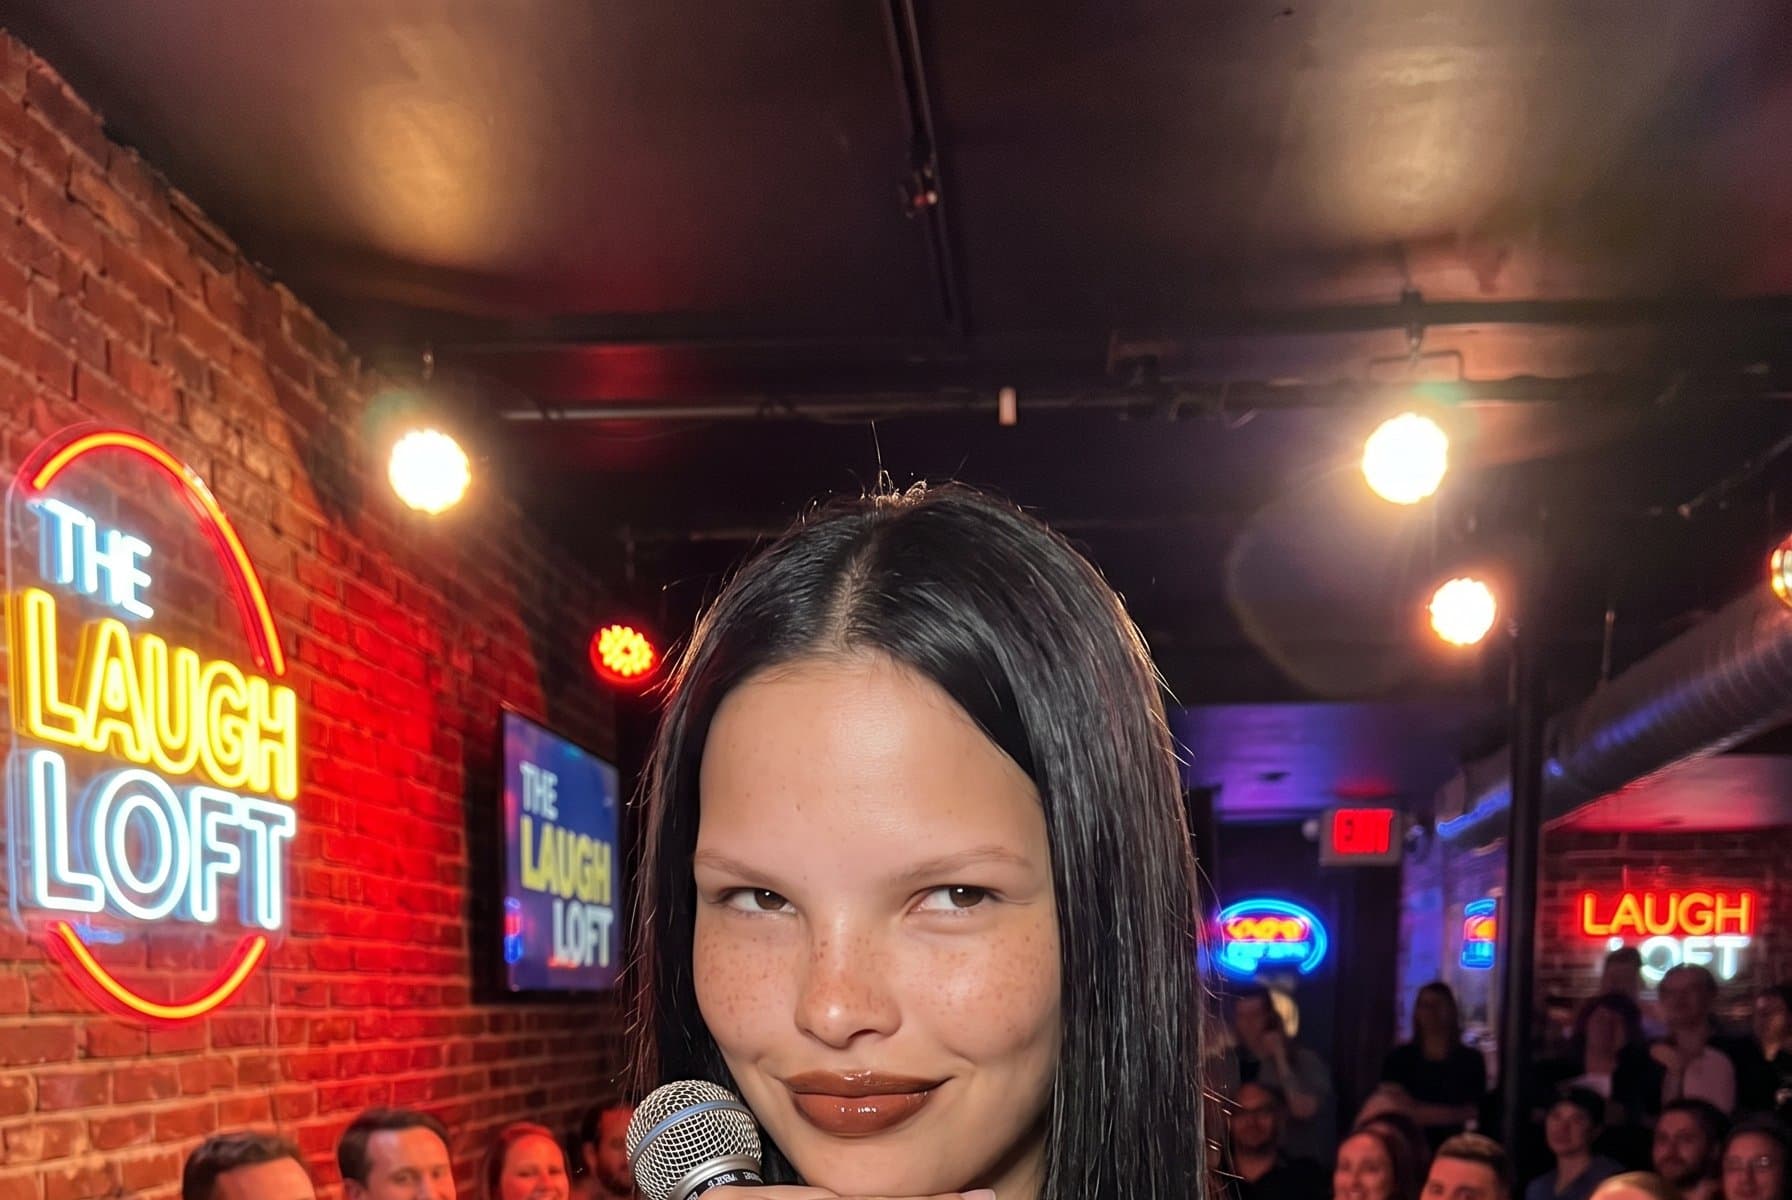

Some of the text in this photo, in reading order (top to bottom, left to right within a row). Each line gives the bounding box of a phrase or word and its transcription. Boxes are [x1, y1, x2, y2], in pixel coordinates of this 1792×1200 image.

[34, 498, 154, 620] THE
[12, 589, 297, 800] LAUGH
[520, 762, 558, 821] THE
[30, 749, 297, 930] LOFT
[520, 816, 612, 905] LAUGH
[553, 900, 614, 968] LOFT
[1583, 893, 1750, 936] LAUGH
[1607, 936, 1751, 981] OFT
